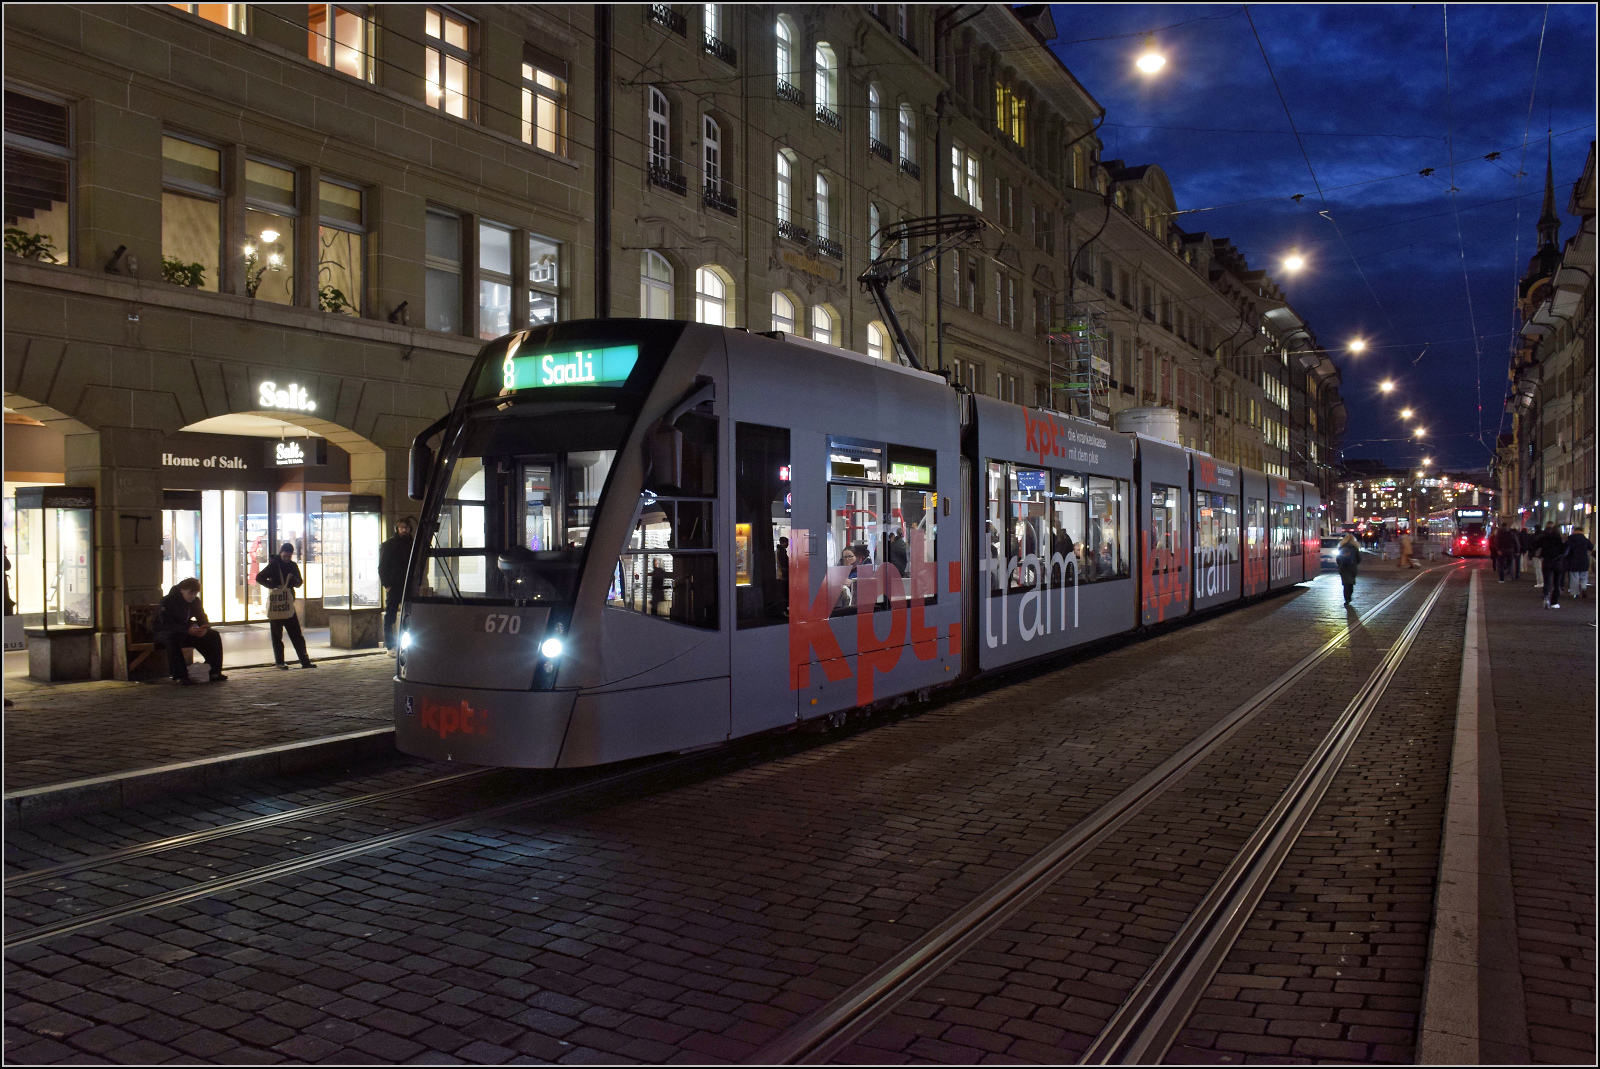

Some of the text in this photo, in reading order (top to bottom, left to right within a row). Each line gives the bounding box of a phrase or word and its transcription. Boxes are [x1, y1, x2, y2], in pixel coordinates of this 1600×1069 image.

[503, 351, 595, 389] 8 Saali
[259, 381, 316, 411] Salt.
[1022, 406, 1066, 465] kpt:
[1067, 428, 1107, 448] die krankenkasse
[162, 453, 248, 470] Home of Salt.
[1068, 447, 1099, 466] mit dem plus
[1142, 530, 1189, 622] kpt:
[1194, 530, 1230, 598] tram
[485, 614, 521, 634] 670
[788, 528, 1080, 707] kpt: tram
[422, 697, 488, 739] kpt:
